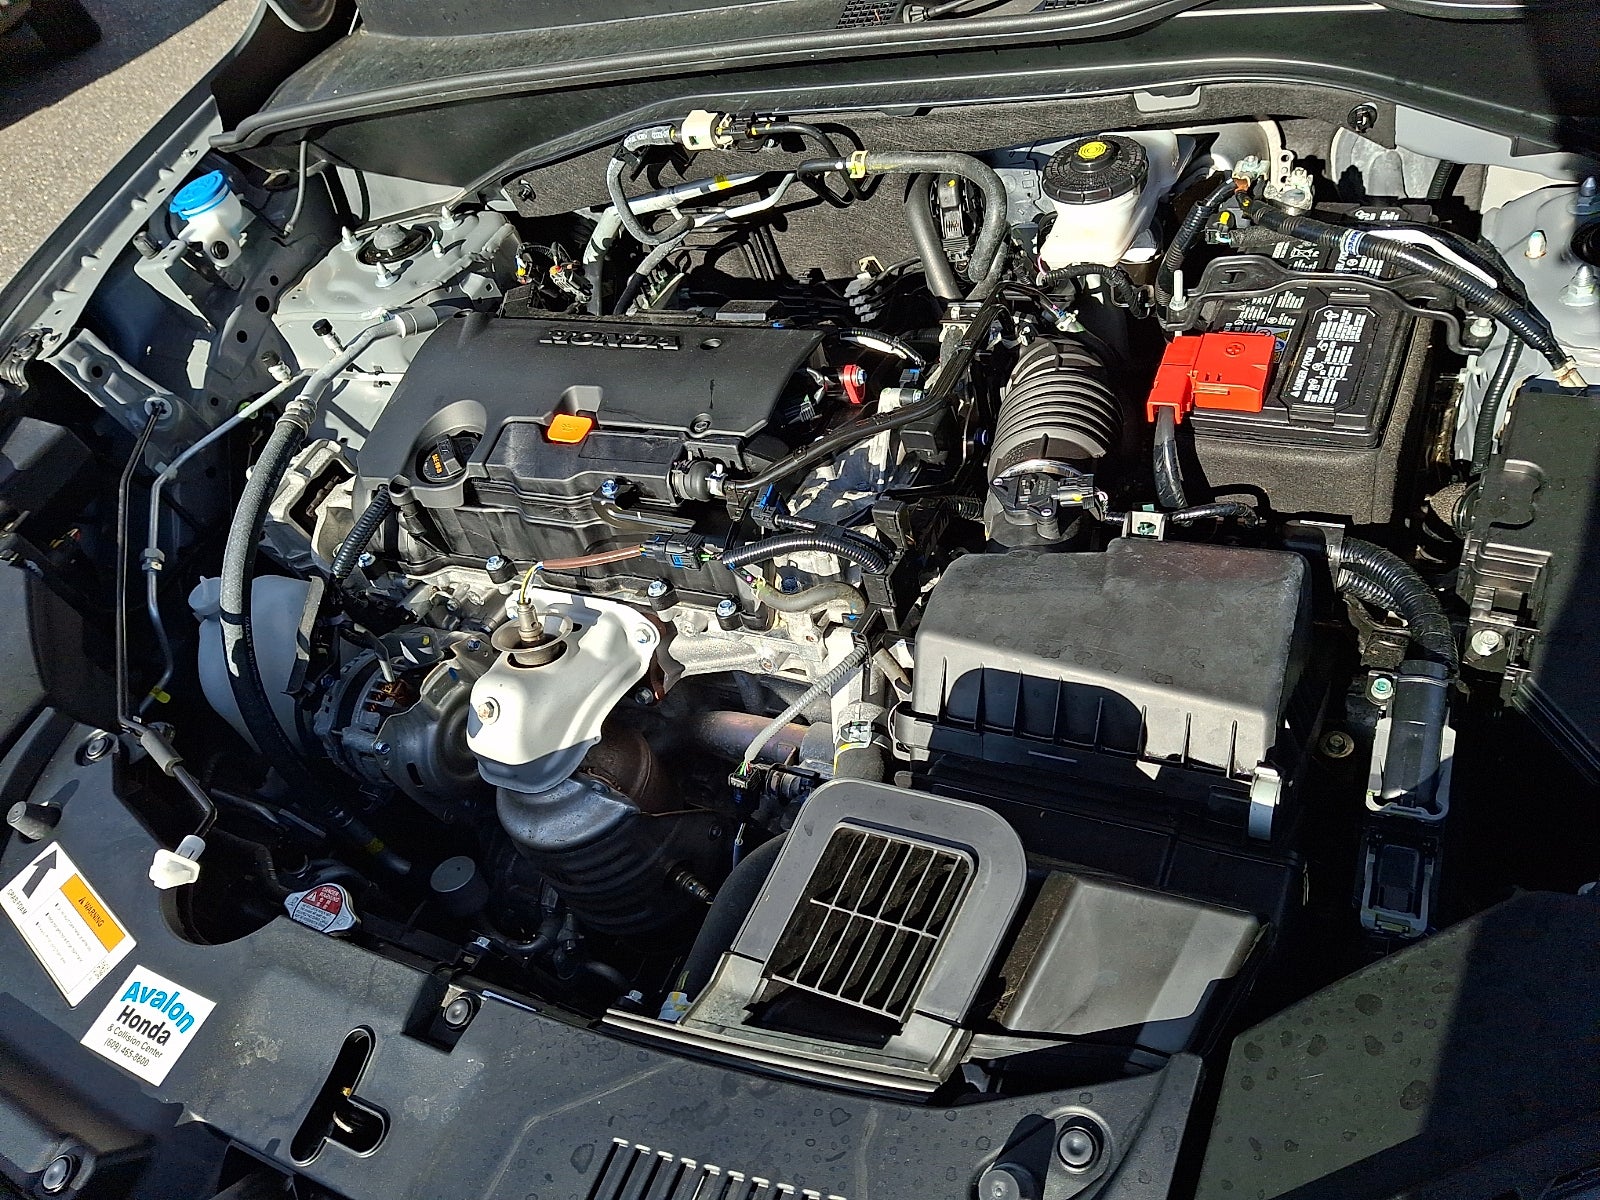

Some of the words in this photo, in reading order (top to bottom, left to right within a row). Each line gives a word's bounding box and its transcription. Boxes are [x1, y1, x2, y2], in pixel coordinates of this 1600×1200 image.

[84, 901, 105, 927] WARNING
[116, 1004, 171, 1047] Honda
[120, 981, 195, 1034] Avalon
[107, 1023, 115, 1032] &
[113, 1026, 141, 1047] Collision
[140, 1041, 163, 1059] Center
